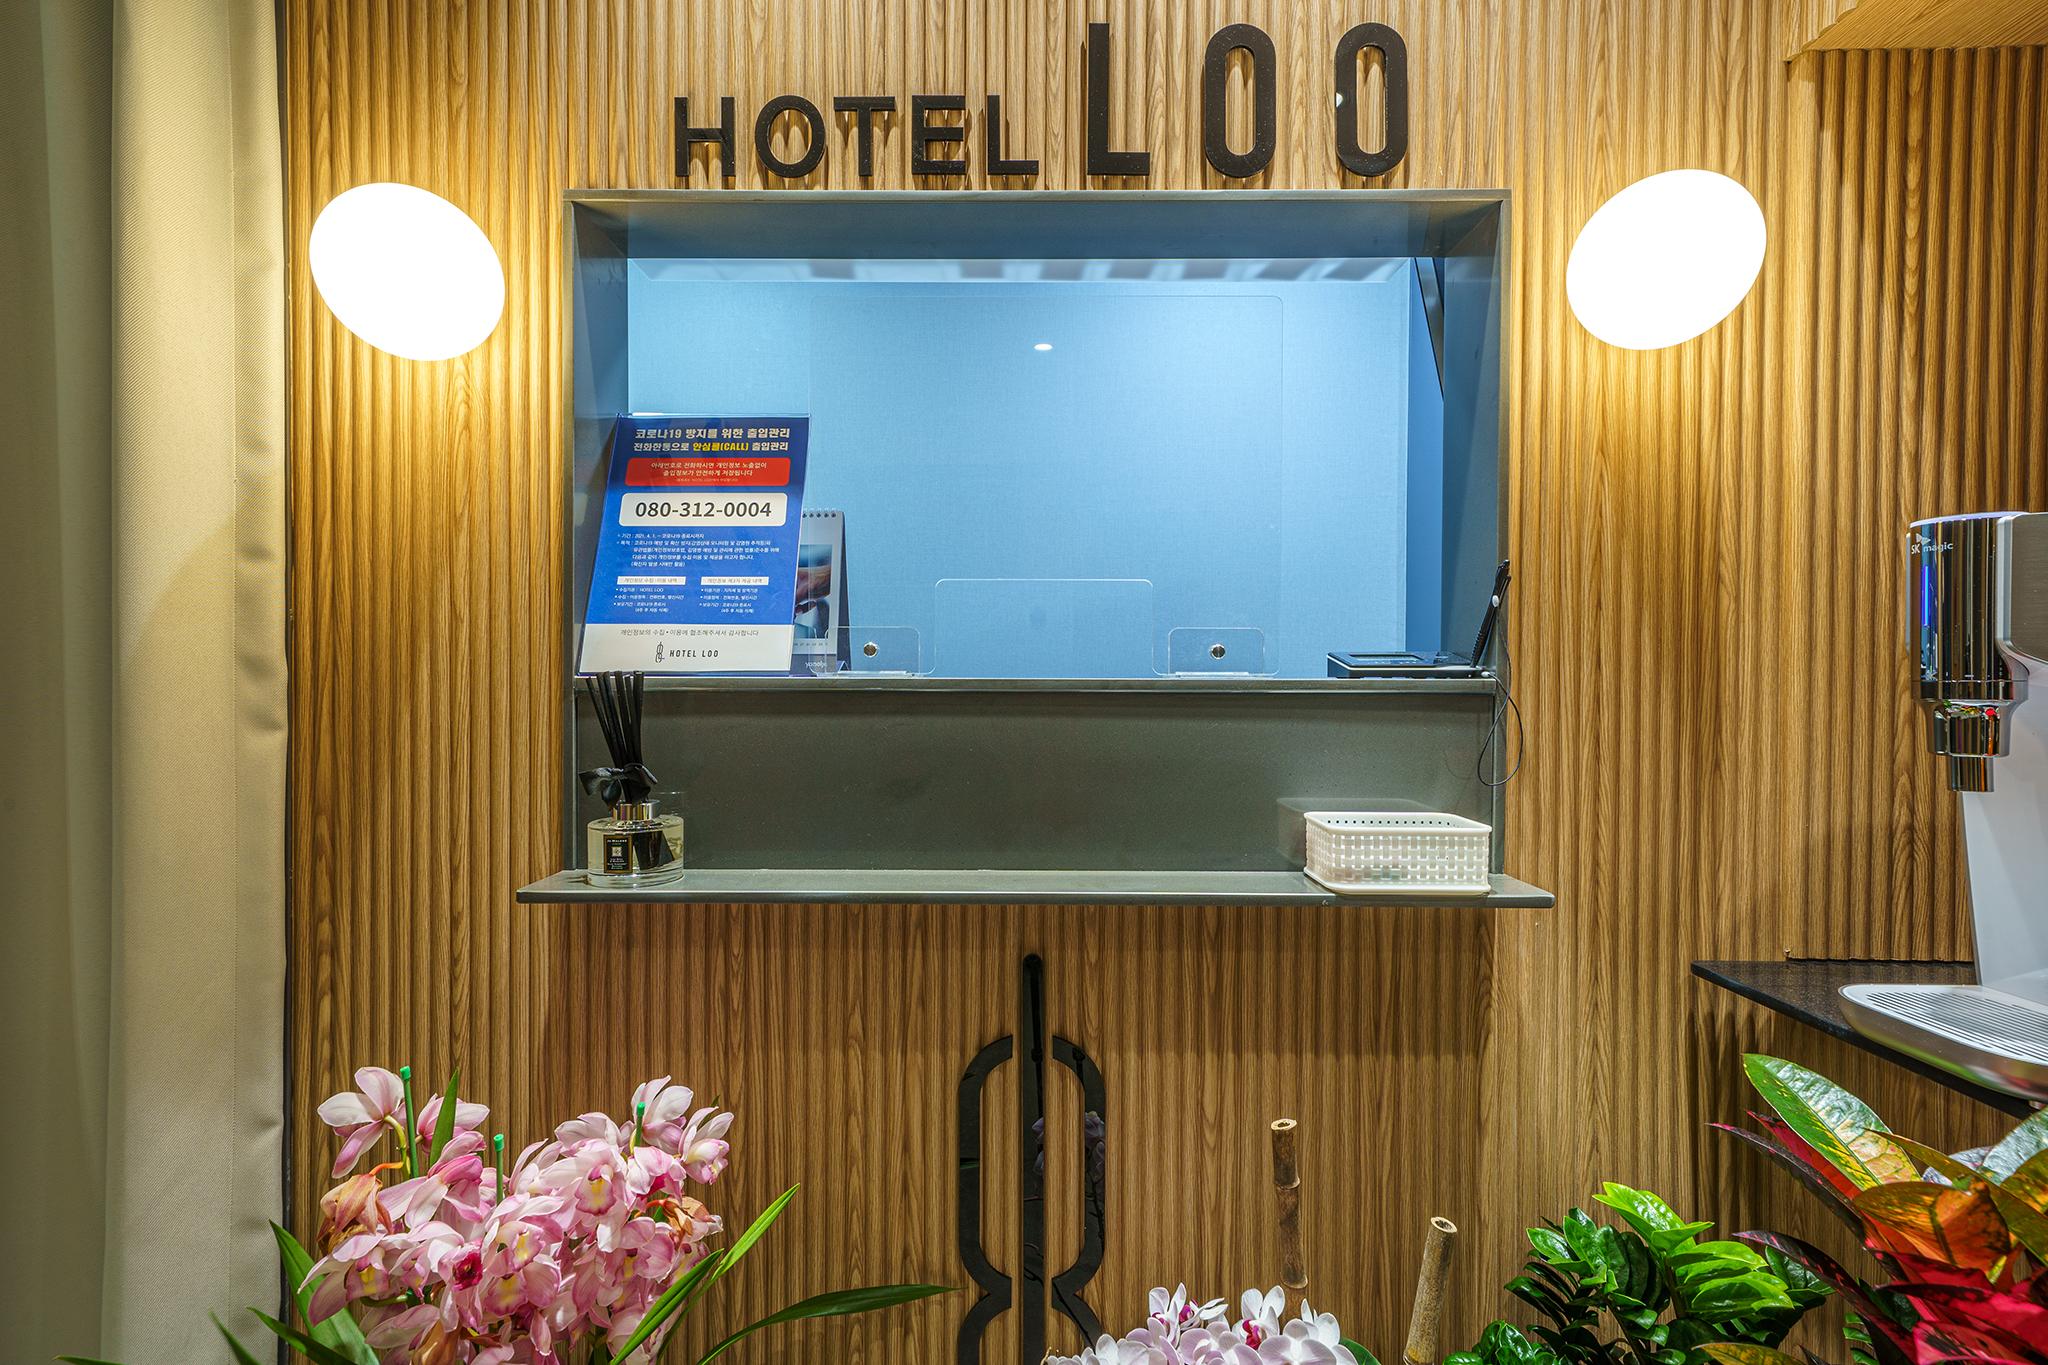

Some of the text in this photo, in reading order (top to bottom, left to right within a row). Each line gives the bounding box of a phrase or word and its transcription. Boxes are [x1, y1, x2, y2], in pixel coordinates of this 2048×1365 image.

[674, 23, 1407, 177] HOTEL LOO
[635, 428, 790, 439] 코로나19 방지를 위한 출입관리
[751, 442, 789, 452] 출입관리
[635, 502, 772, 517] 080-312-0004
[1911, 541, 1954, 555] SK magic
